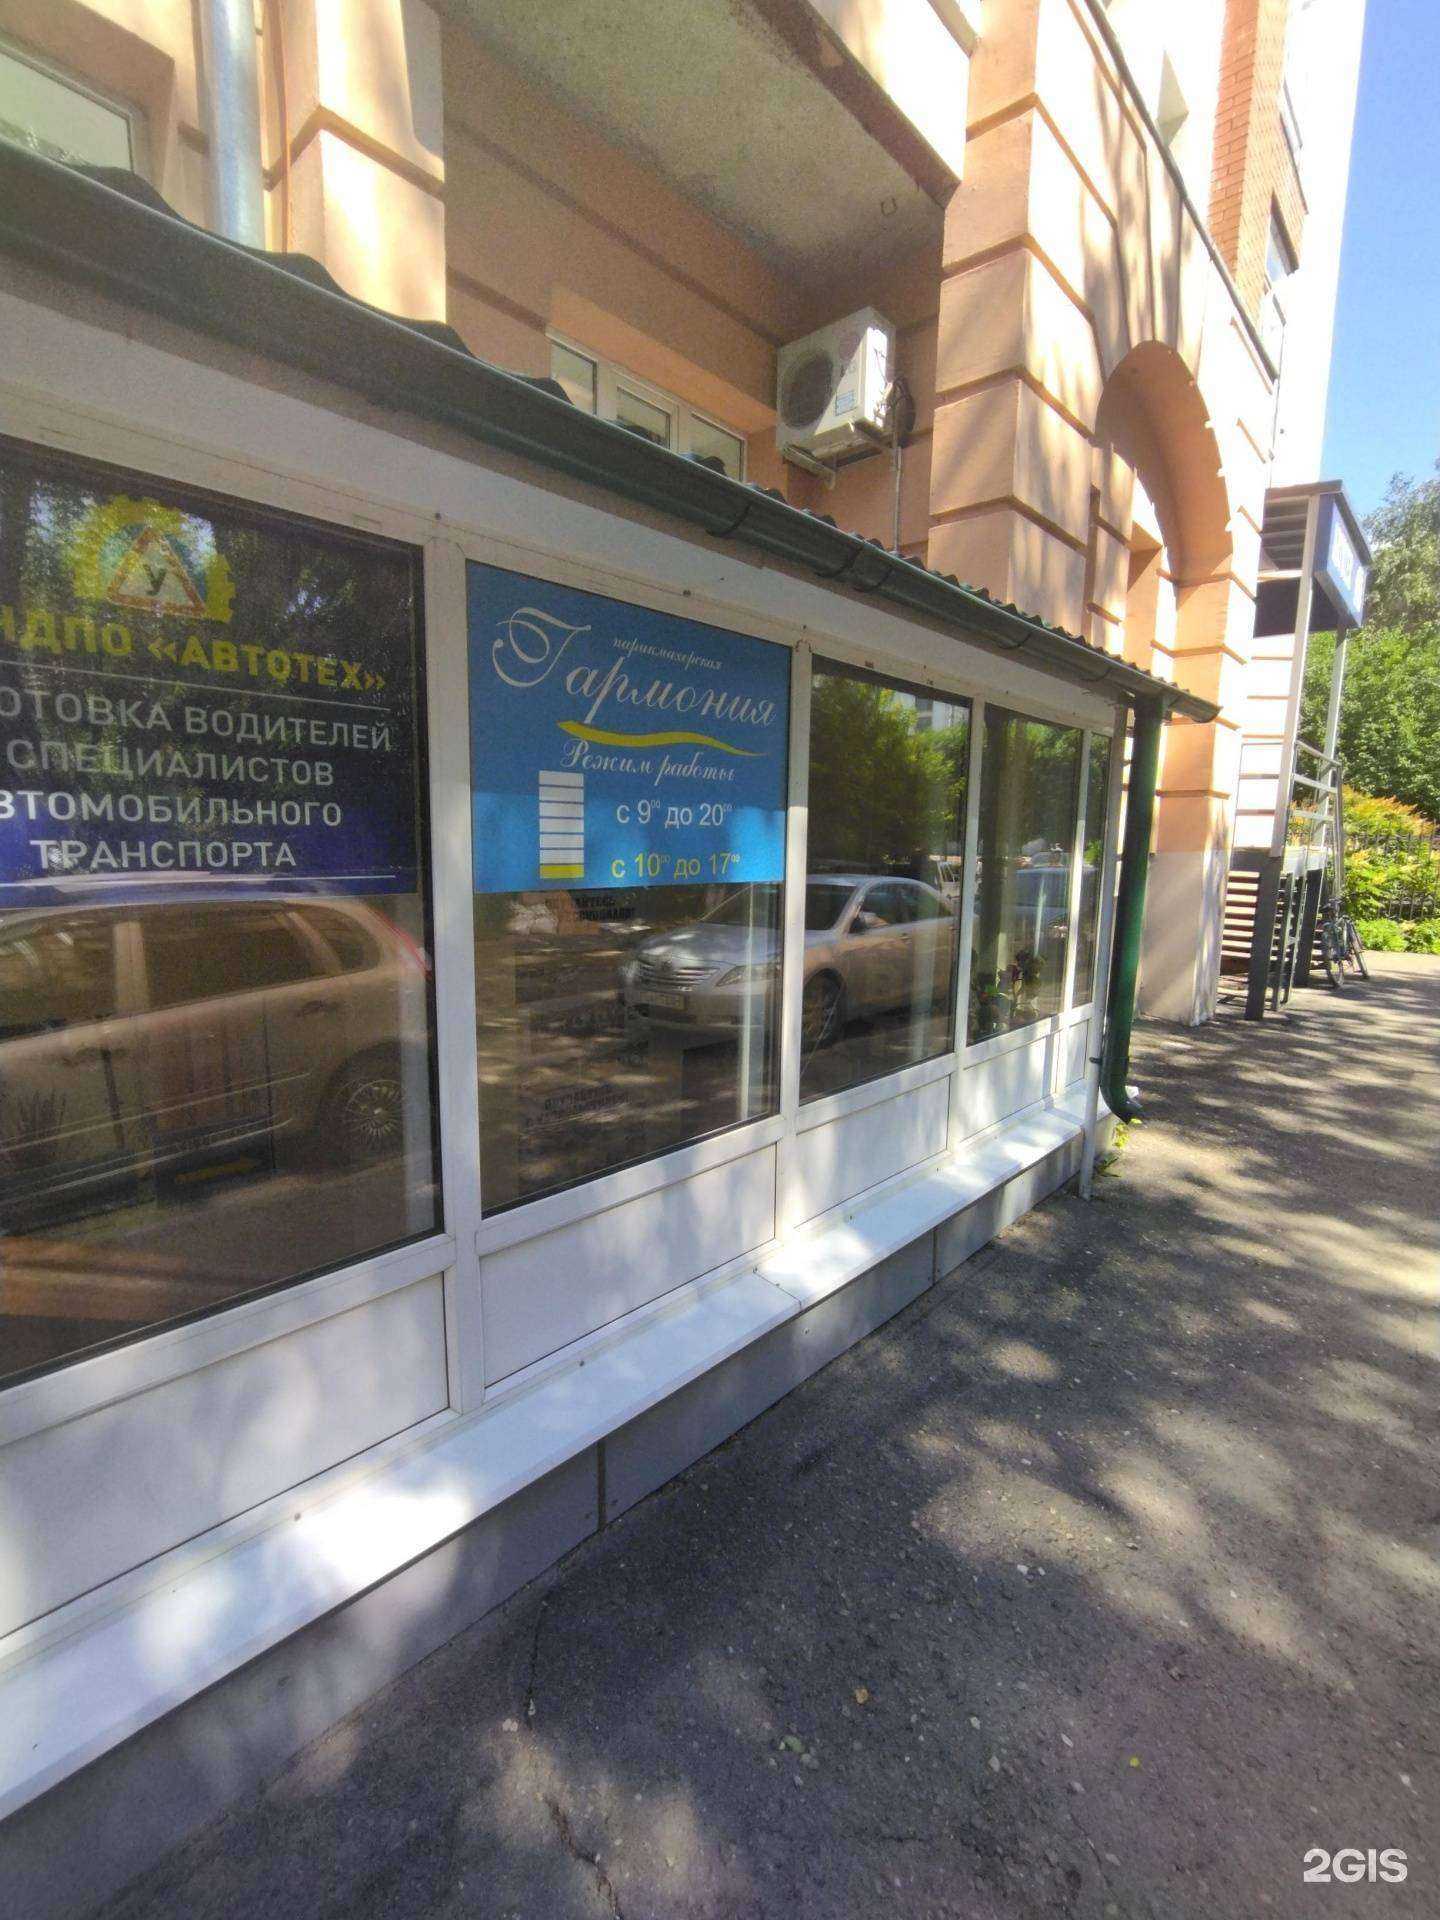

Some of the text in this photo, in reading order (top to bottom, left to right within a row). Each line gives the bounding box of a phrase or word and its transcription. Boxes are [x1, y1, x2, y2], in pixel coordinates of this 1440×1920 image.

[147, 636, 386, 691] «АВТОТЕХ»
[492, 606, 777, 725] Гармония
[612, 637, 723, 671] парикмахерская
[185, 706, 393, 752] ВОДИТЕЛЕЙ
[7, 739, 334, 786] СПЕЦИАЛИСТОВ
[560, 737, 736, 786] Режим работы
[664, 807, 693, 829] до
[29, 838, 297, 869] ТРАНСПОРТА
[674, 856, 701, 879] до
